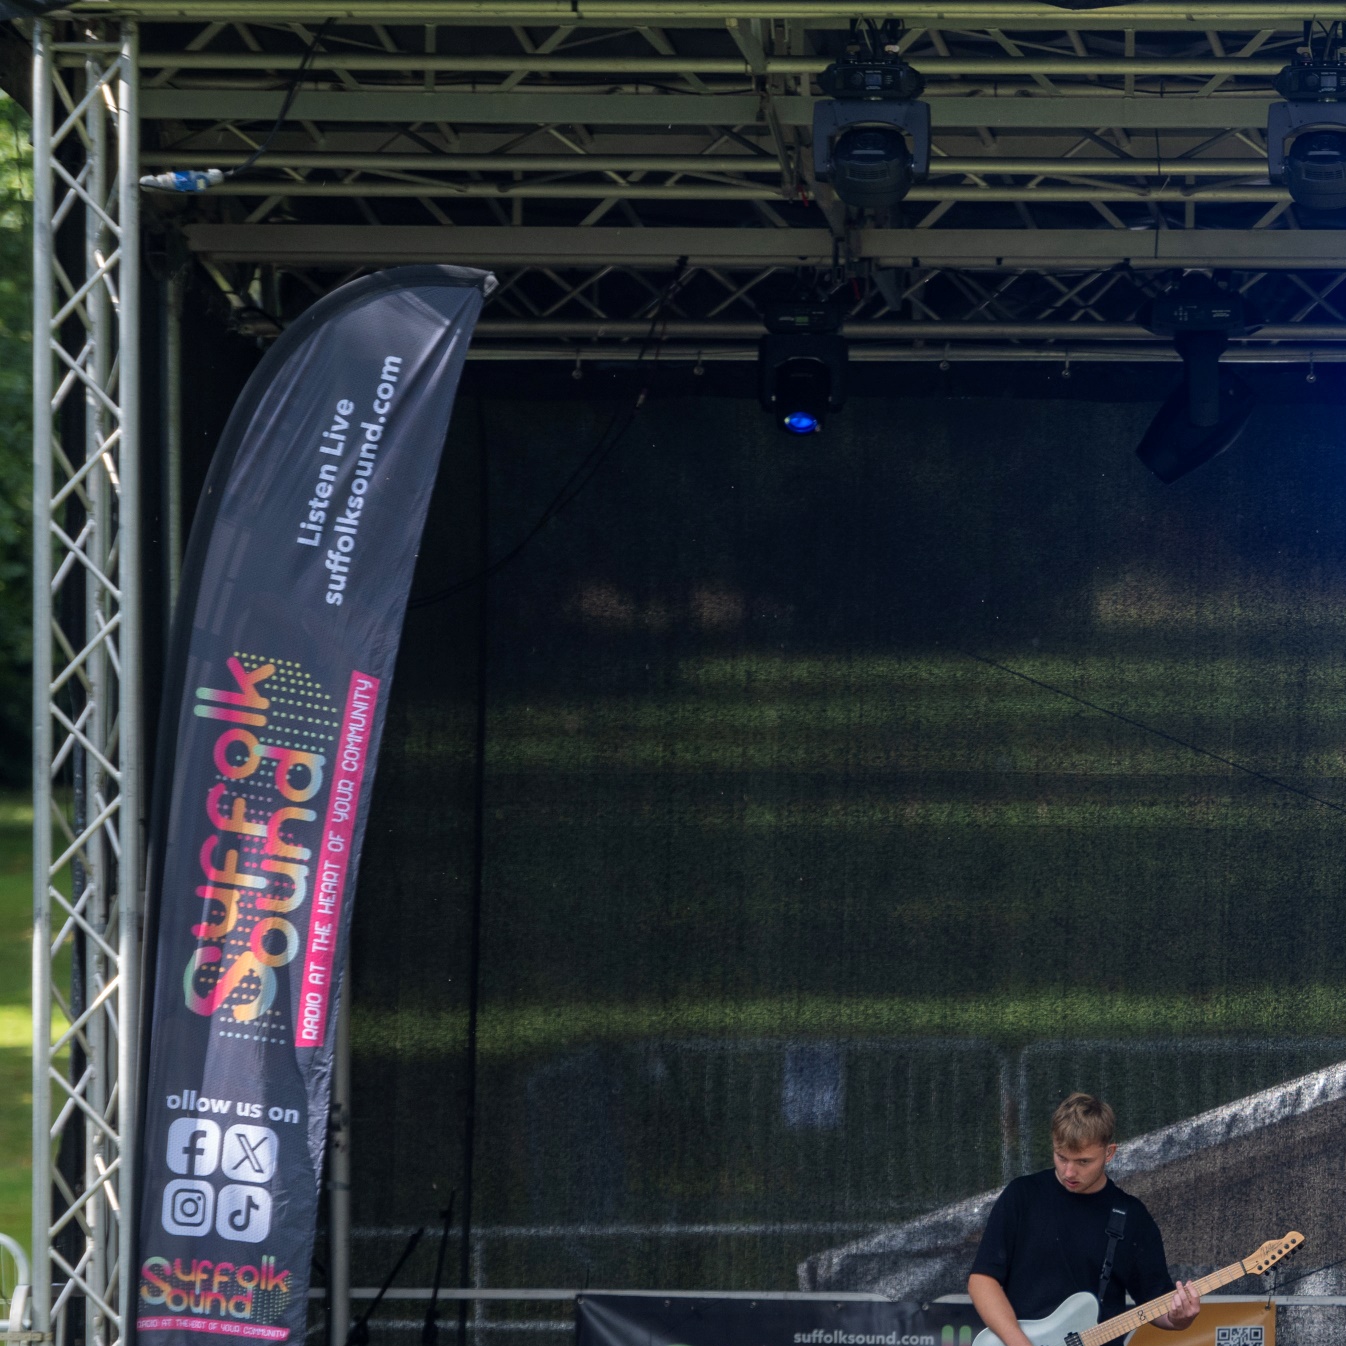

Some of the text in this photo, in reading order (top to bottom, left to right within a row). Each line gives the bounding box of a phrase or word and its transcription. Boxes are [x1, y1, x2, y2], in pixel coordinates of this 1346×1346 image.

[297, 399, 355, 547] Listen Live
[325, 355, 403, 607] suffolksound.com
[183, 655, 278, 1021] Suffolk
[301, 678, 374, 1041] RADIO AT THE HEART OF YOUR COMMUNITY
[166, 1090, 300, 1124] ollow us on
[140, 1254, 290, 1305] Suffolk
[793, 1329, 935, 1346] suffolksound.com
